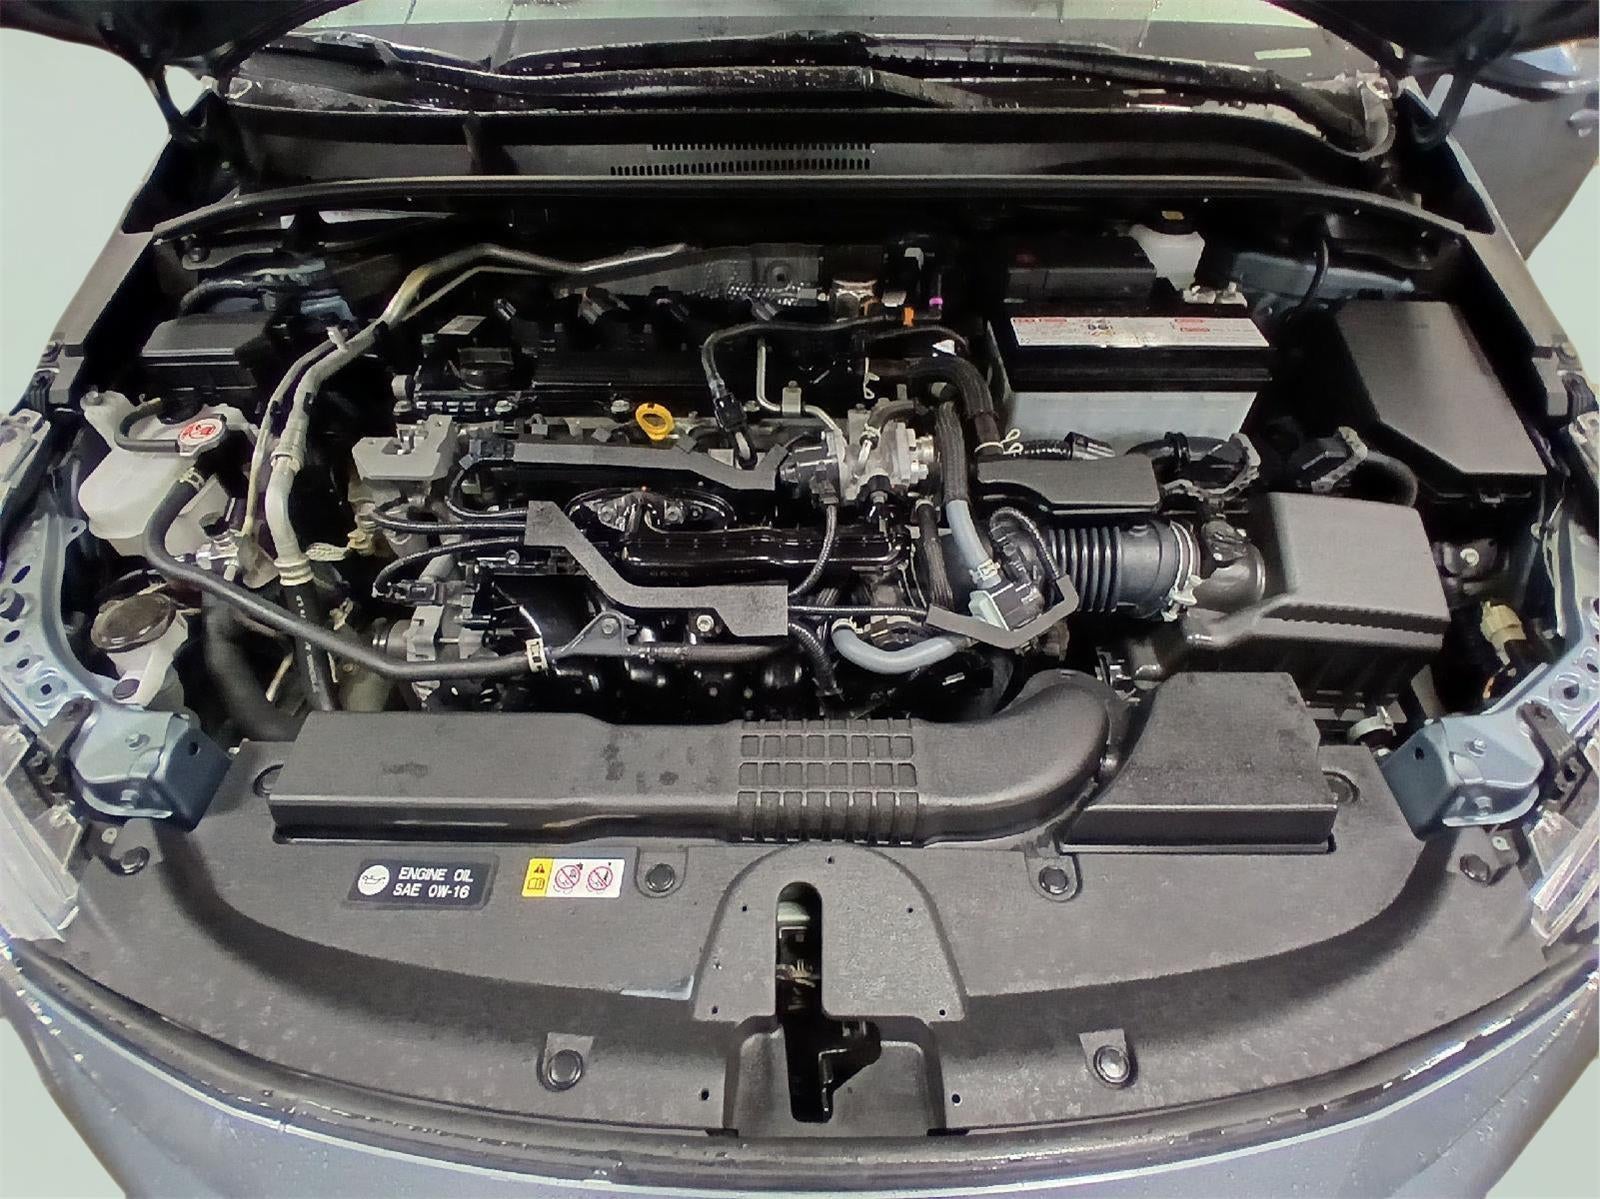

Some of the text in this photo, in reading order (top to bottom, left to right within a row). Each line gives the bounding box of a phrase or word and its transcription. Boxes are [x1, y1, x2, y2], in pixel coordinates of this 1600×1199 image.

[398, 866, 474, 883] ENGINE OIL
[392, 882, 470, 899] SAE 0W-16
